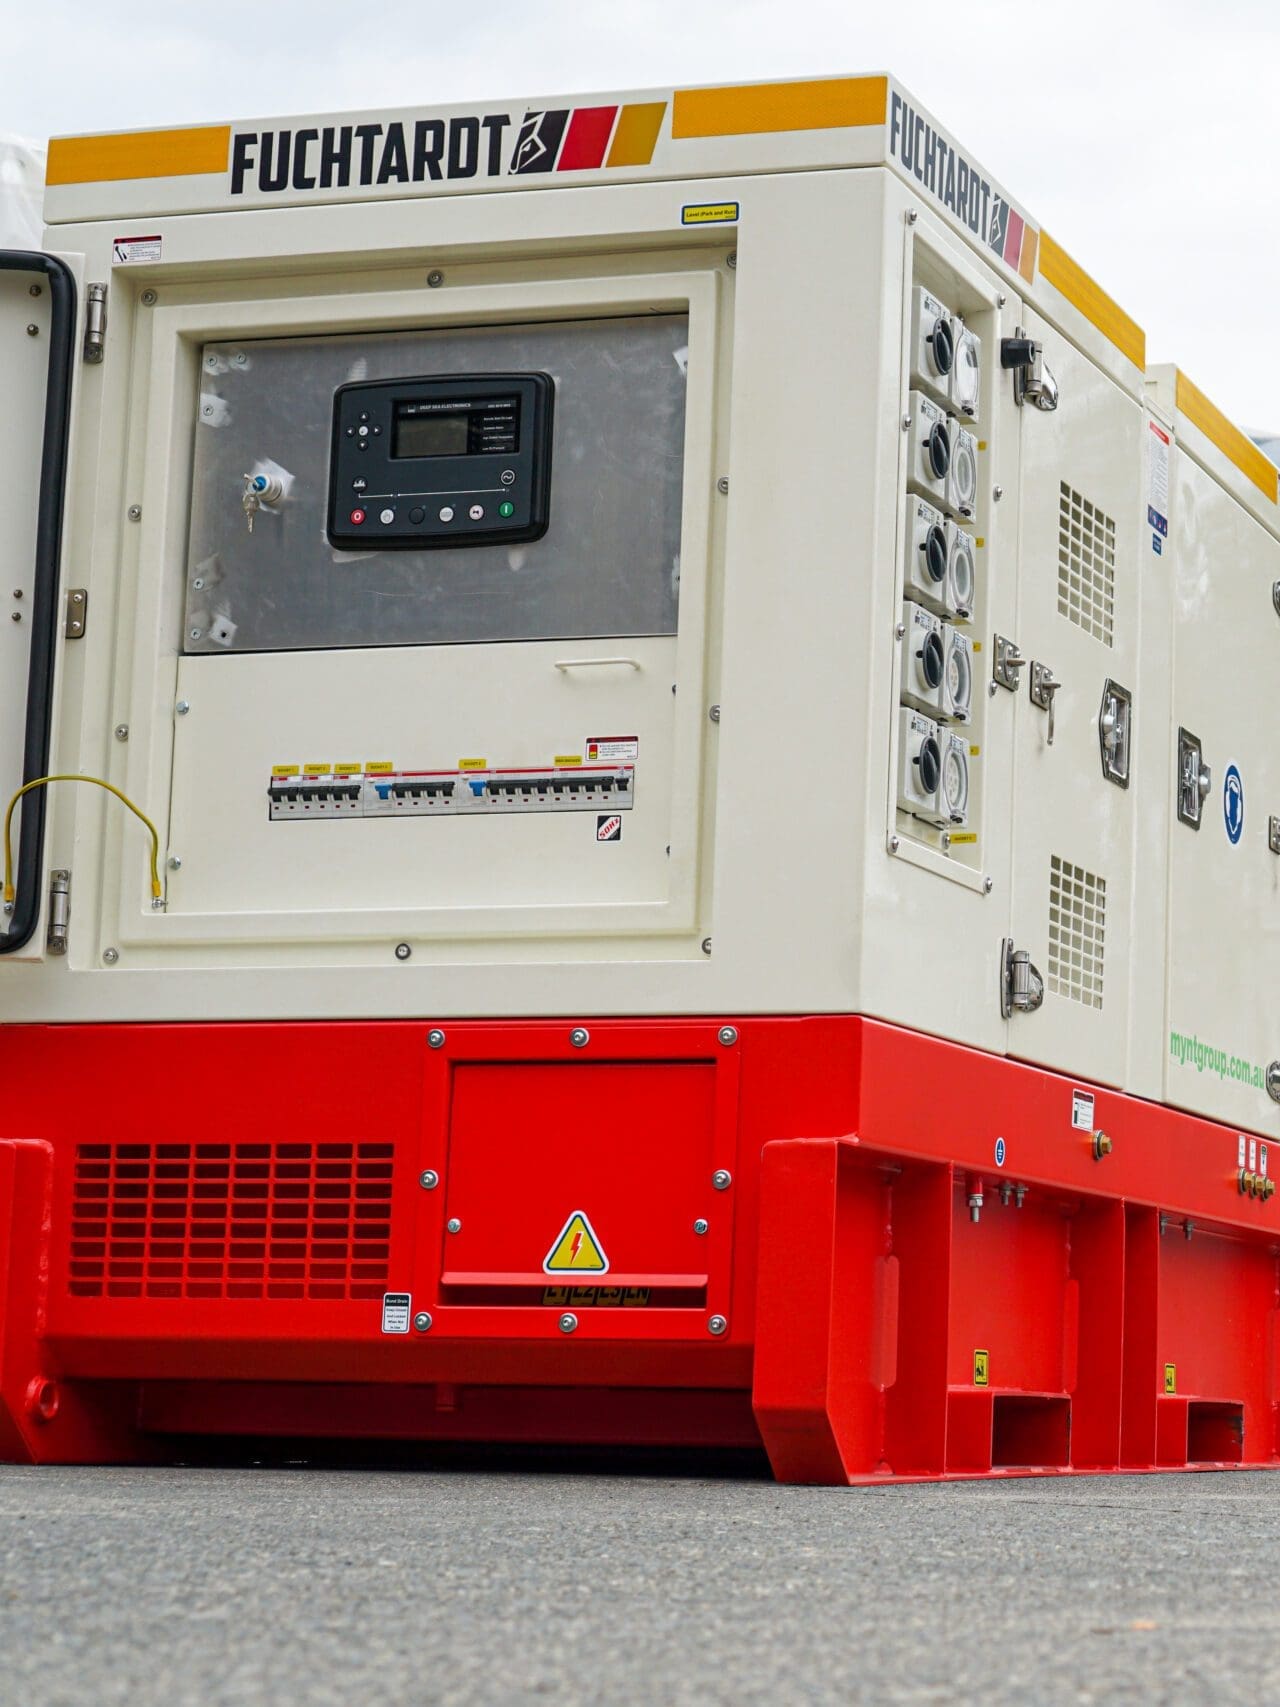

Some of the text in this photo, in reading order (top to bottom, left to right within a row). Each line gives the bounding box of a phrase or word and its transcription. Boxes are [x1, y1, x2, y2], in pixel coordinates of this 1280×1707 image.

[231, 114, 511, 194] FUCHTARDT
[890, 90, 991, 243] FUCHTARDT
[1170, 1032, 1265, 1090] myntgroup.com.au
